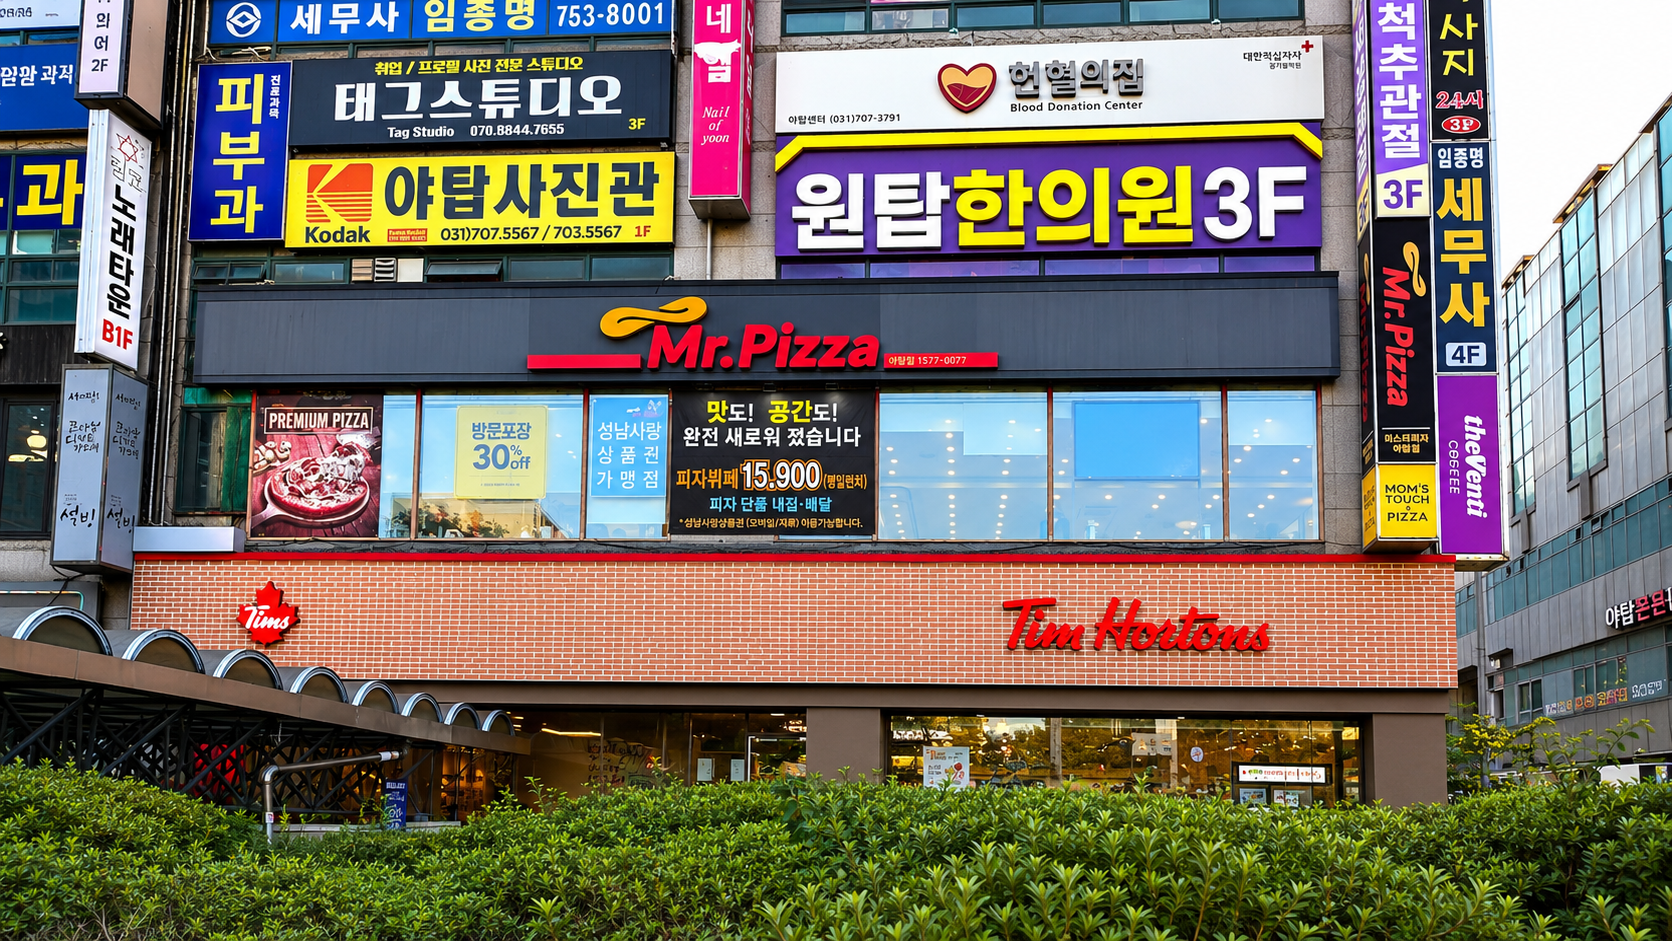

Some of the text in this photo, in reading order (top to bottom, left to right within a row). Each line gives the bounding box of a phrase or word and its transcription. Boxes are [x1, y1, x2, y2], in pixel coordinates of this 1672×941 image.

[290, 0, 664, 35] 세무사 임종명 753-8001
[1439, 0, 1479, 76] 사지
[91, 59, 109, 72] 2F
[374, 61, 402, 75] 취업
[463, 59, 491, 73] 사진
[494, 58, 523, 72] 전문
[526, 56, 584, 71] 스튜디오
[1008, 58, 1145, 98] 헌혈의집
[1377, 2, 1422, 159] 척추관절
[334, 75, 622, 122] 태그스튜디오
[1010, 99, 1144, 113] Blood Donation Center
[702, 106, 730, 118] Nail
[829, 113, 901, 124] (031)707-3791
[388, 125, 455, 139] Tag Studio
[470, 123, 565, 137] 070.8844.7655
[628, 118, 646, 130] 3F
[708, 119, 724, 131] of
[700, 134, 729, 146] yoon
[210, 74, 265, 233] 피부과
[1437, 147, 1484, 169] 임종명
[0, 159, 84, 225] 과
[385, 161, 660, 221] 야탑사진관
[1383, 180, 1424, 209] 3F
[305, 226, 371, 243] Kodak
[553, 225, 622, 240] 703.5567
[634, 225, 651, 238] 1F
[107, 184, 137, 320] 노래타운
[1436, 178, 1490, 328] 세무사
[102, 318, 133, 350] B1F
[1451, 345, 1480, 364] 4F
[269, 412, 369, 429] PREMIUM PIZZA
[706, 400, 838, 423] 맛도! 공간도!
[472, 422, 532, 440] 방문포장
[598, 421, 662, 441] 성남사랑
[683, 426, 861, 447] 완전 새로워 졌습니다
[510, 456, 531, 469] off
[1385, 483, 1429, 494] MOM'S
[709, 496, 737, 512] 피자
[1385, 494, 1430, 504] TOUCH
[1387, 512, 1428, 522] PIZZA
[244, 605, 290, 630] Tims
[1002, 596, 1270, 651] Tim Hortons
